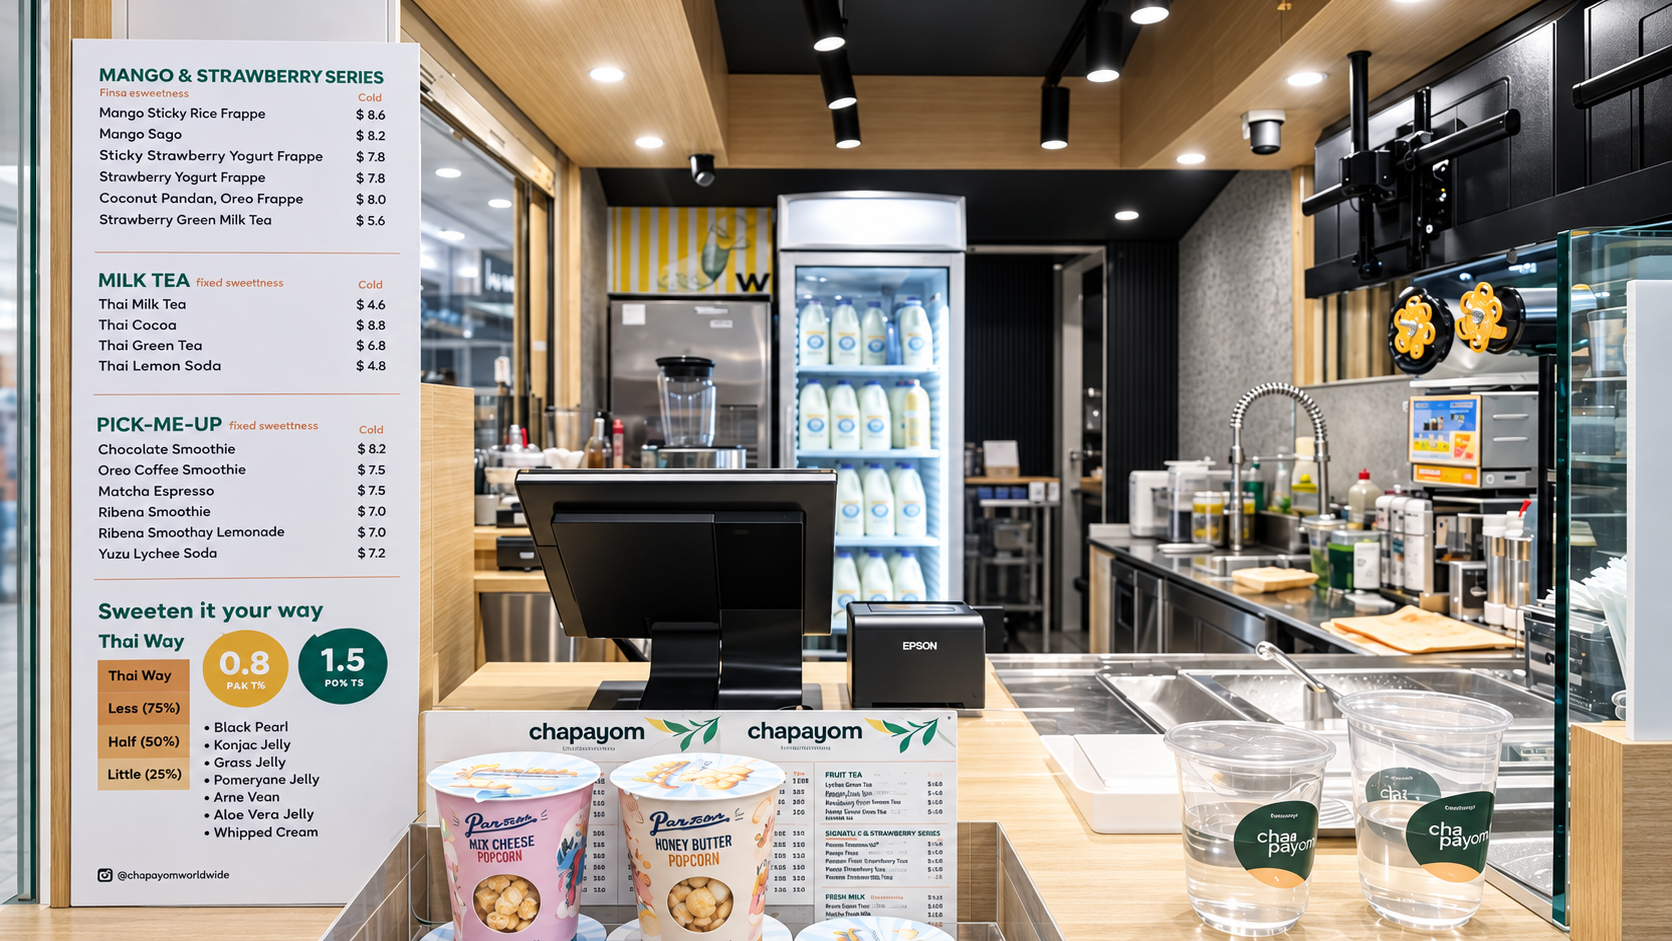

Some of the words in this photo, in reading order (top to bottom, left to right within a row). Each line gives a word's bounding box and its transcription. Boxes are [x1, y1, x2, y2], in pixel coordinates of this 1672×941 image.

[99, 67, 174, 83] MANGO
[178, 68, 192, 83] &
[196, 68, 322, 84] STRAWBERRY
[325, 69, 385, 84] SERIES
[100, 88, 127, 97] Finsa
[129, 90, 189, 98] esweetness
[358, 93, 382, 102] Cold
[100, 107, 144, 121] Mango
[148, 108, 187, 121] Sticky
[191, 108, 217, 118] Rice
[221, 108, 265, 121] Frappe
[368, 110, 385, 120] 8.6
[100, 128, 144, 142] Mango
[148, 129, 182, 142] Sago
[368, 131, 385, 141] 8.2
[100, 150, 143, 163] Sticky
[148, 150, 225, 164] Strawberry
[230, 151, 273, 164] Yogurt
[278, 151, 323, 164] Frappe
[368, 152, 385, 162] 7.8
[100, 171, 171, 185] Strawberry
[175, 172, 217, 185] Yogurt
[221, 172, 265, 185] Frappe
[368, 173, 385, 183] 7.8
[100, 193, 157, 203] Coconut
[162, 192, 216, 205] Pandan,
[221, 193, 253, 204] Oreo
[258, 193, 303, 207] Frappe
[368, 195, 386, 204] 8.0
[100, 214, 173, 227] Strawberry
[177, 214, 215, 225] Green
[220, 214, 245, 225] Milk
[249, 215, 271, 225] Tea
[368, 216, 385, 226] 5.6
[99, 273, 146, 287] MILK
[151, 273, 190, 287] TEA
[196, 278, 222, 287] fixed
[226, 279, 283, 287] sweettness
[358, 280, 382, 289] Cold
[99, 299, 127, 309] Thai
[132, 298, 159, 309] Milk
[163, 299, 186, 309] Tea
[367, 300, 385, 310] 4.6
[99, 319, 128, 330] Thai
[132, 319, 176, 330] Cocoa
[368, 320, 385, 330] 8.8
[99, 340, 128, 351] Thai
[133, 340, 174, 351] Green
[178, 340, 202, 350] Tea
[368, 341, 386, 350] 6.8
[99, 360, 128, 371] Thai
[133, 361, 180, 371] Lemon
[185, 360, 221, 371] Soda
[368, 361, 386, 371] 4.8
[97, 417, 222, 432] PICK-ME-UP
[229, 421, 256, 430] fixed
[259, 422, 318, 430] sweettness
[359, 425, 383, 434] Cold
[98, 444, 168, 455] Chocolate
[172, 443, 235, 454] Smoothie
[369, 444, 386, 454] 8.2
[98, 465, 131, 476] Oreo
[135, 464, 178, 475] Coffee
[183, 464, 246, 475] Smoothie
[369, 465, 385, 475] 7.5
[99, 485, 149, 496] Matcha
[154, 486, 214, 499] Espresso
[368, 486, 385, 495] 7.5
[99, 507, 144, 517] Ribena
[148, 506, 210, 517] Smoothie
[369, 506, 386, 516] 7.0
[99, 527, 144, 538] Ribena
[148, 526, 213, 540] Smoothay
[217, 526, 284, 537] Lemonade
[369, 527, 386, 537] 7.0
[99, 549, 129, 559] Yuzu
[134, 548, 180, 561] Lychee
[184, 547, 217, 558] Soda
[369, 548, 385, 558] 7.2
[99, 603, 193, 619] Sweeten
[201, 601, 215, 618] it
[222, 606, 272, 623] your
[278, 606, 323, 622] way
[98, 633, 138, 648] Thai
[144, 634, 184, 652] Way
[902, 641, 938, 651] EPSON
[220, 651, 269, 675] 0.8
[321, 648, 365, 671] 1.5
[108, 670, 137, 681] Thai
[142, 670, 172, 683] Way
[109, 703, 138, 713] Less
[143, 702, 180, 715] (75%)
[215, 721, 251, 732] Black
[256, 721, 288, 732] Pearl
[529, 723, 644, 744] chapayom
[748, 722, 862, 744] chapayom
[109, 736, 136, 747] Half
[141, 736, 179, 749] (50%)
[215, 740, 257, 753] Konjac
[261, 739, 291, 752] Jelly
[214, 757, 251, 768] Grass
[256, 756, 286, 770] Jelly
[108, 769, 141, 780] Little
[145, 769, 182, 781] (25%)
[215, 775, 286, 787] Pomeryane
[290, 774, 320, 787] Jelly
[825, 771, 847, 779] FRUIT
[848, 771, 863, 779] TEA
[214, 792, 244, 802] Arne
[248, 792, 279, 802] Vean
[214, 809, 244, 820] Aloe
[248, 809, 279, 819] Vera
[283, 808, 314, 822] Jelly
[214, 827, 272, 840] Whipped
[276, 827, 318, 837] Cream
[1428, 821, 1462, 836] cha
[469, 838, 489, 850] MIX
[492, 835, 535, 850] CHEESE
[655, 838, 689, 851] HONEY
[692, 834, 732, 851] BUTTER
[1439, 830, 1489, 851] payom
[1268, 837, 1315, 858] payom
[477, 850, 522, 863] POPCORN
[668, 852, 720, 867] POPCORN
[117, 870, 229, 881] @chapayomworldwide
[848, 893, 866, 901] MILK
